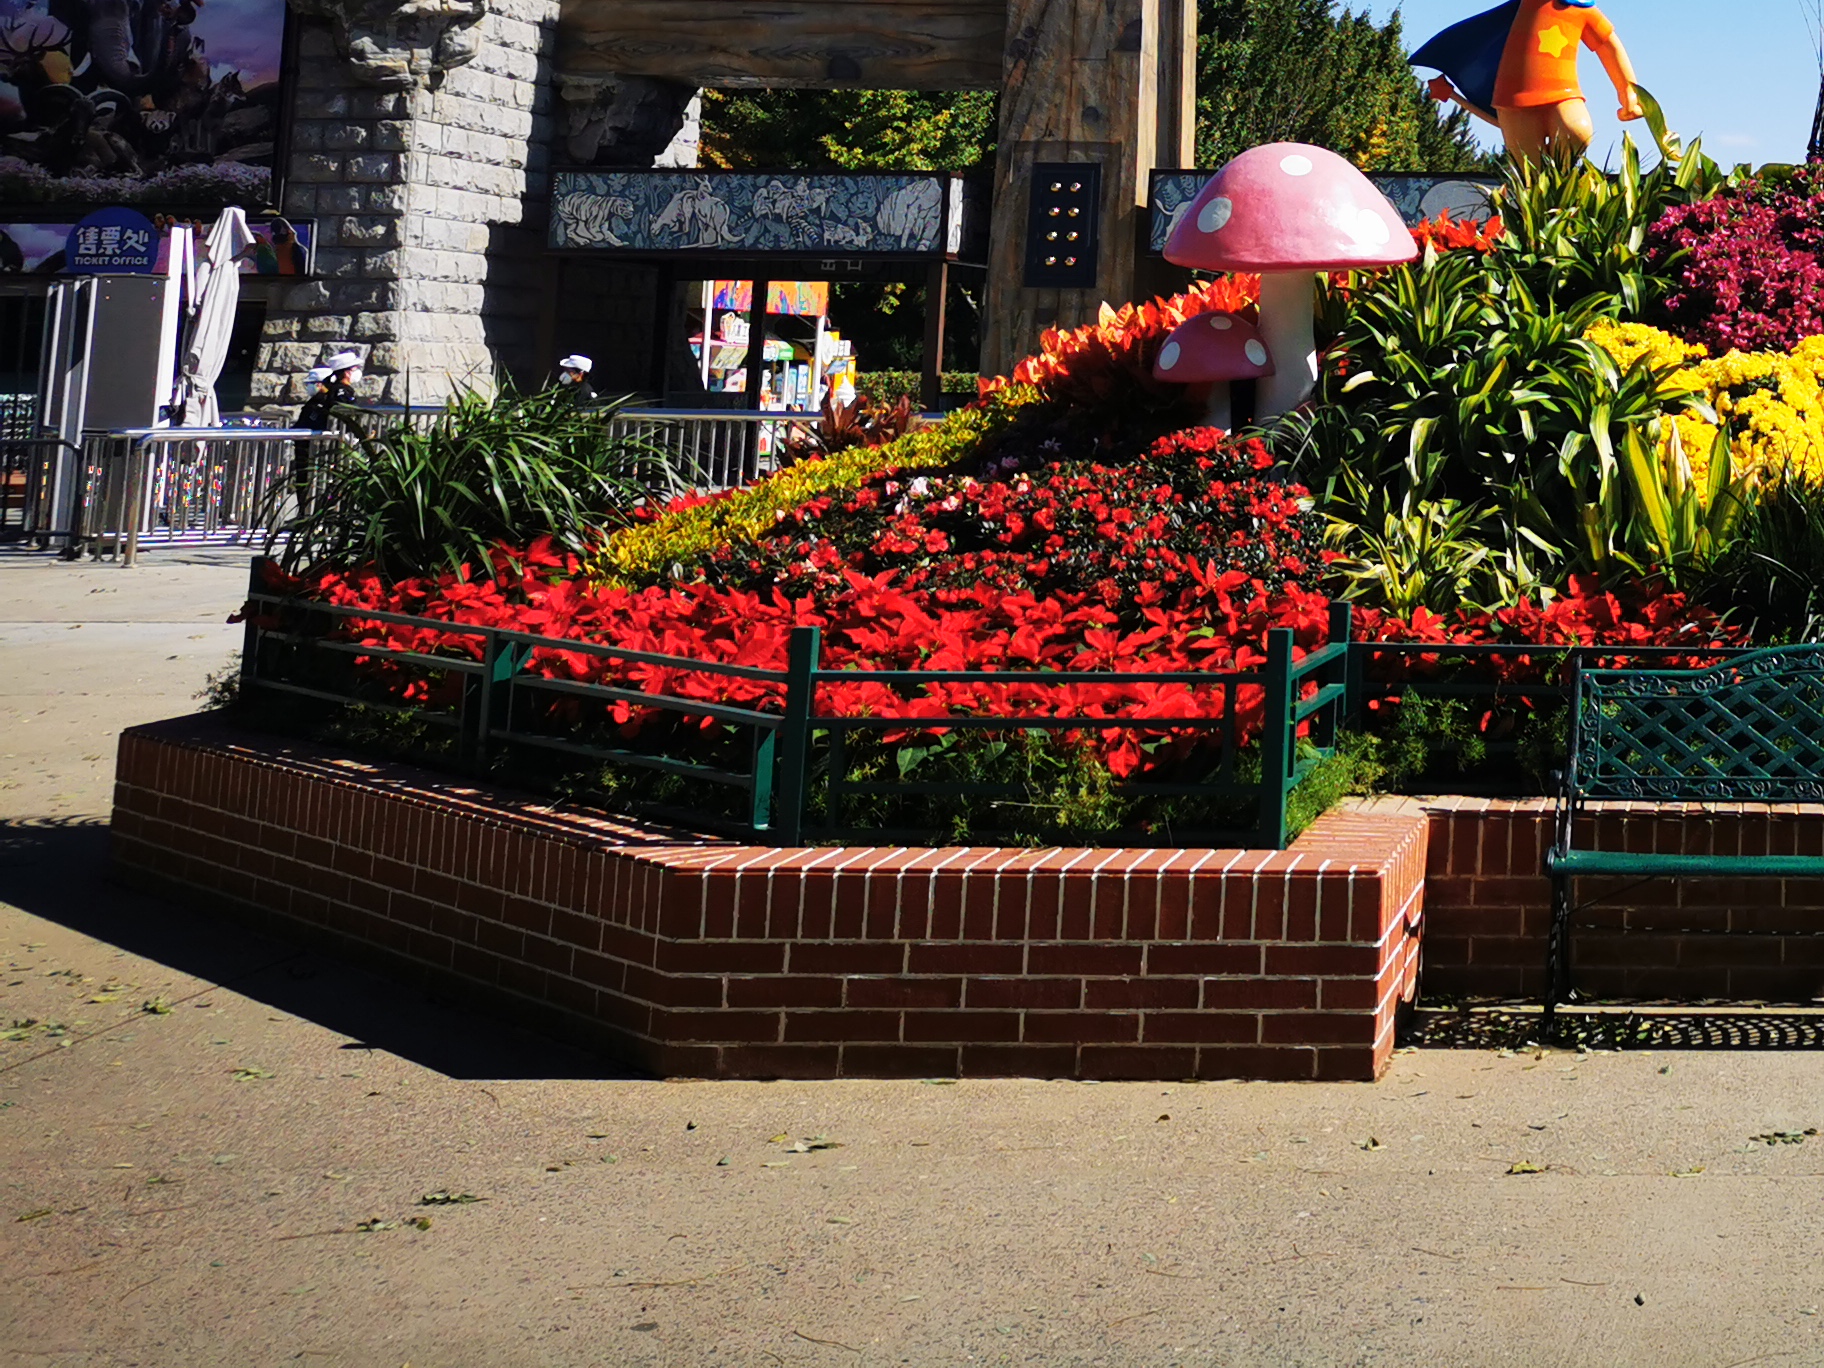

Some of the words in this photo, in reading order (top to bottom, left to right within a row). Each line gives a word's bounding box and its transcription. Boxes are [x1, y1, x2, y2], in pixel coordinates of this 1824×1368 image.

[76, 225, 149, 254] 售票处
[74, 256, 109, 265] TICKET
[112, 256, 148, 265] OFFICE
